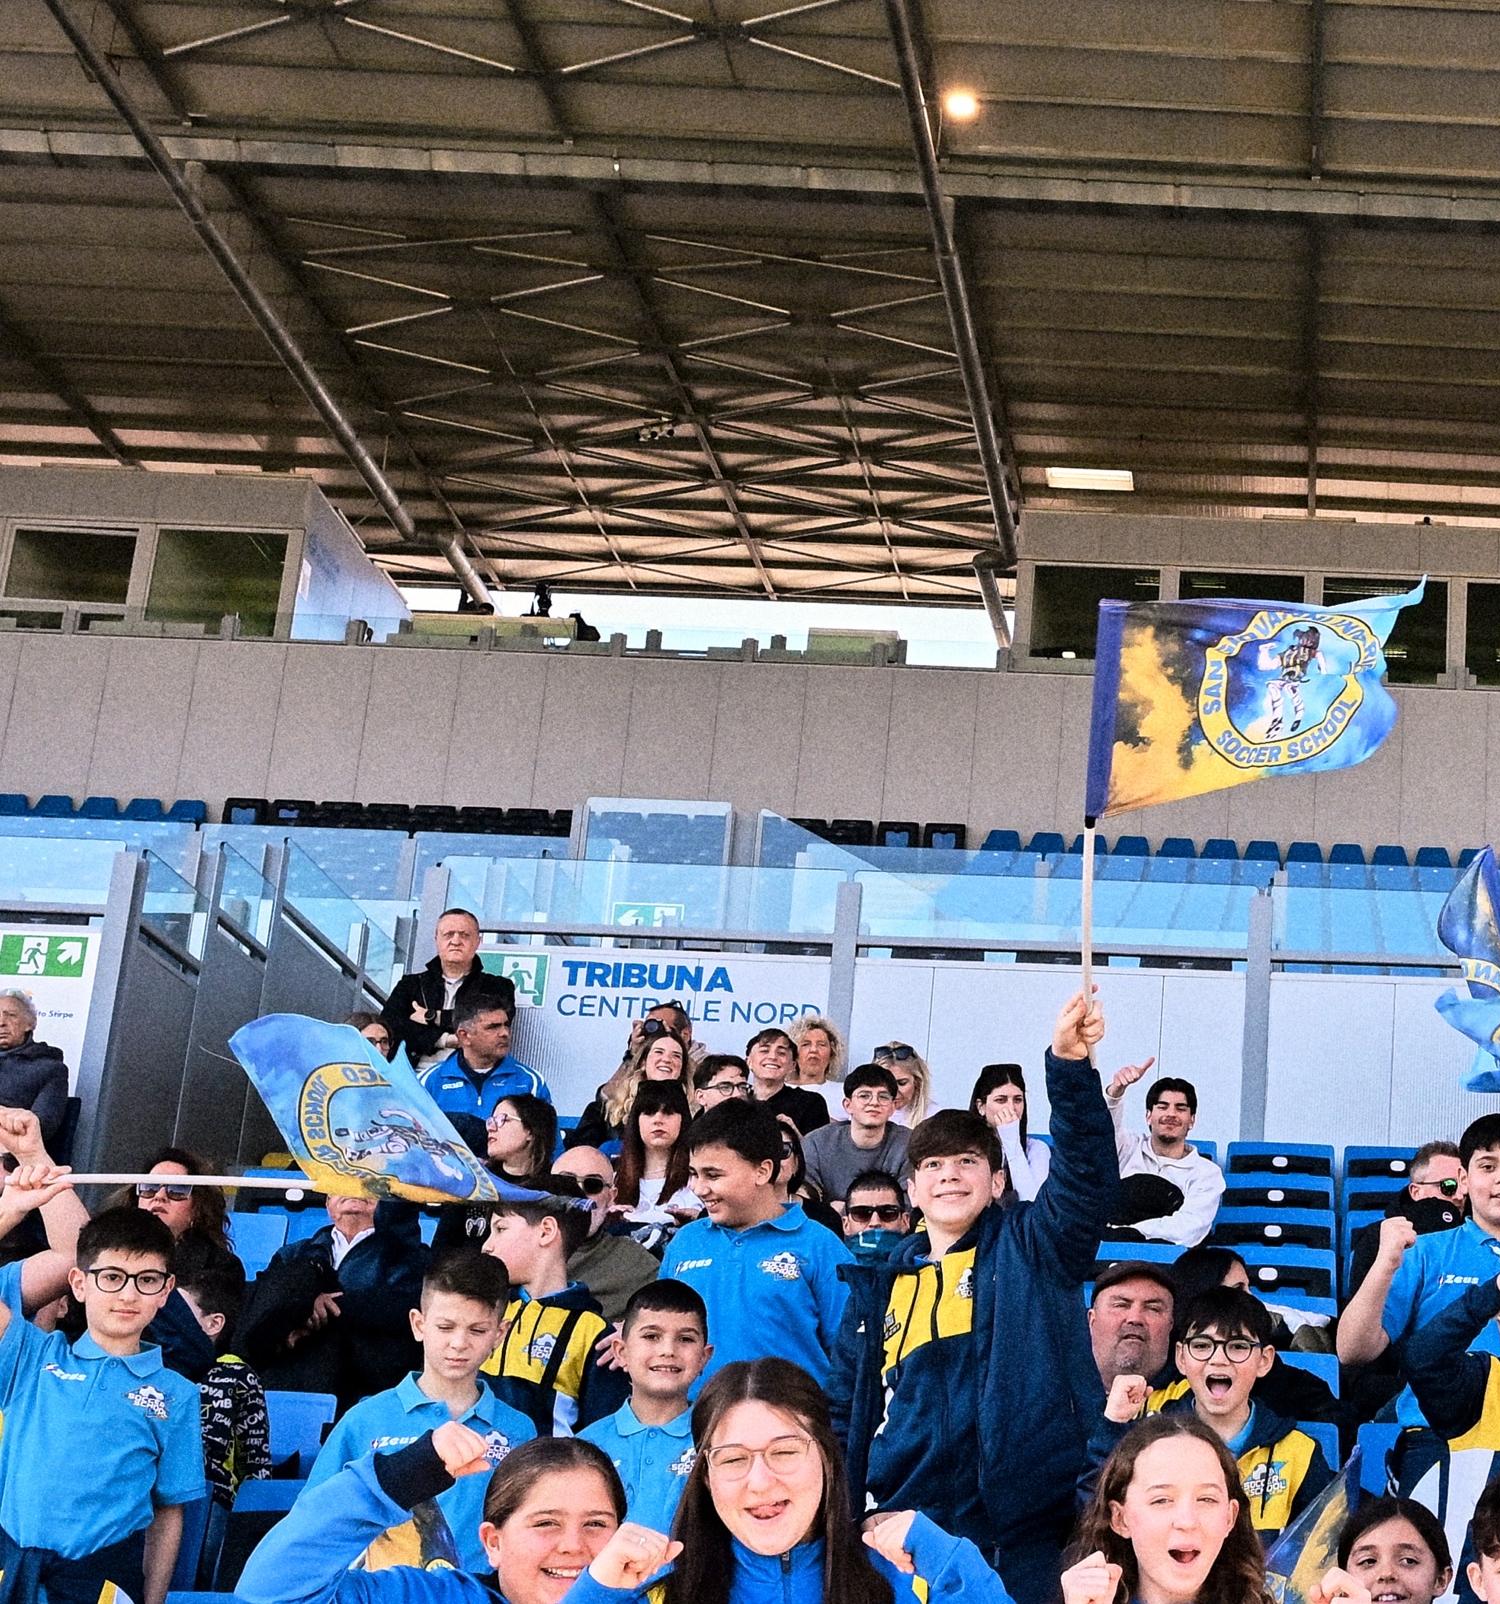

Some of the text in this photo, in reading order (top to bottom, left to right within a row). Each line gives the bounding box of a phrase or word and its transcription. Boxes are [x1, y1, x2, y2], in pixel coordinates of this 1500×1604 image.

[1203, 660, 1223, 715] SAN
[1216, 699, 1357, 763] SOCCER SCHOOL
[562, 960, 733, 993] TRIBUNA
[557, 994, 721, 1022] CENTRLE
